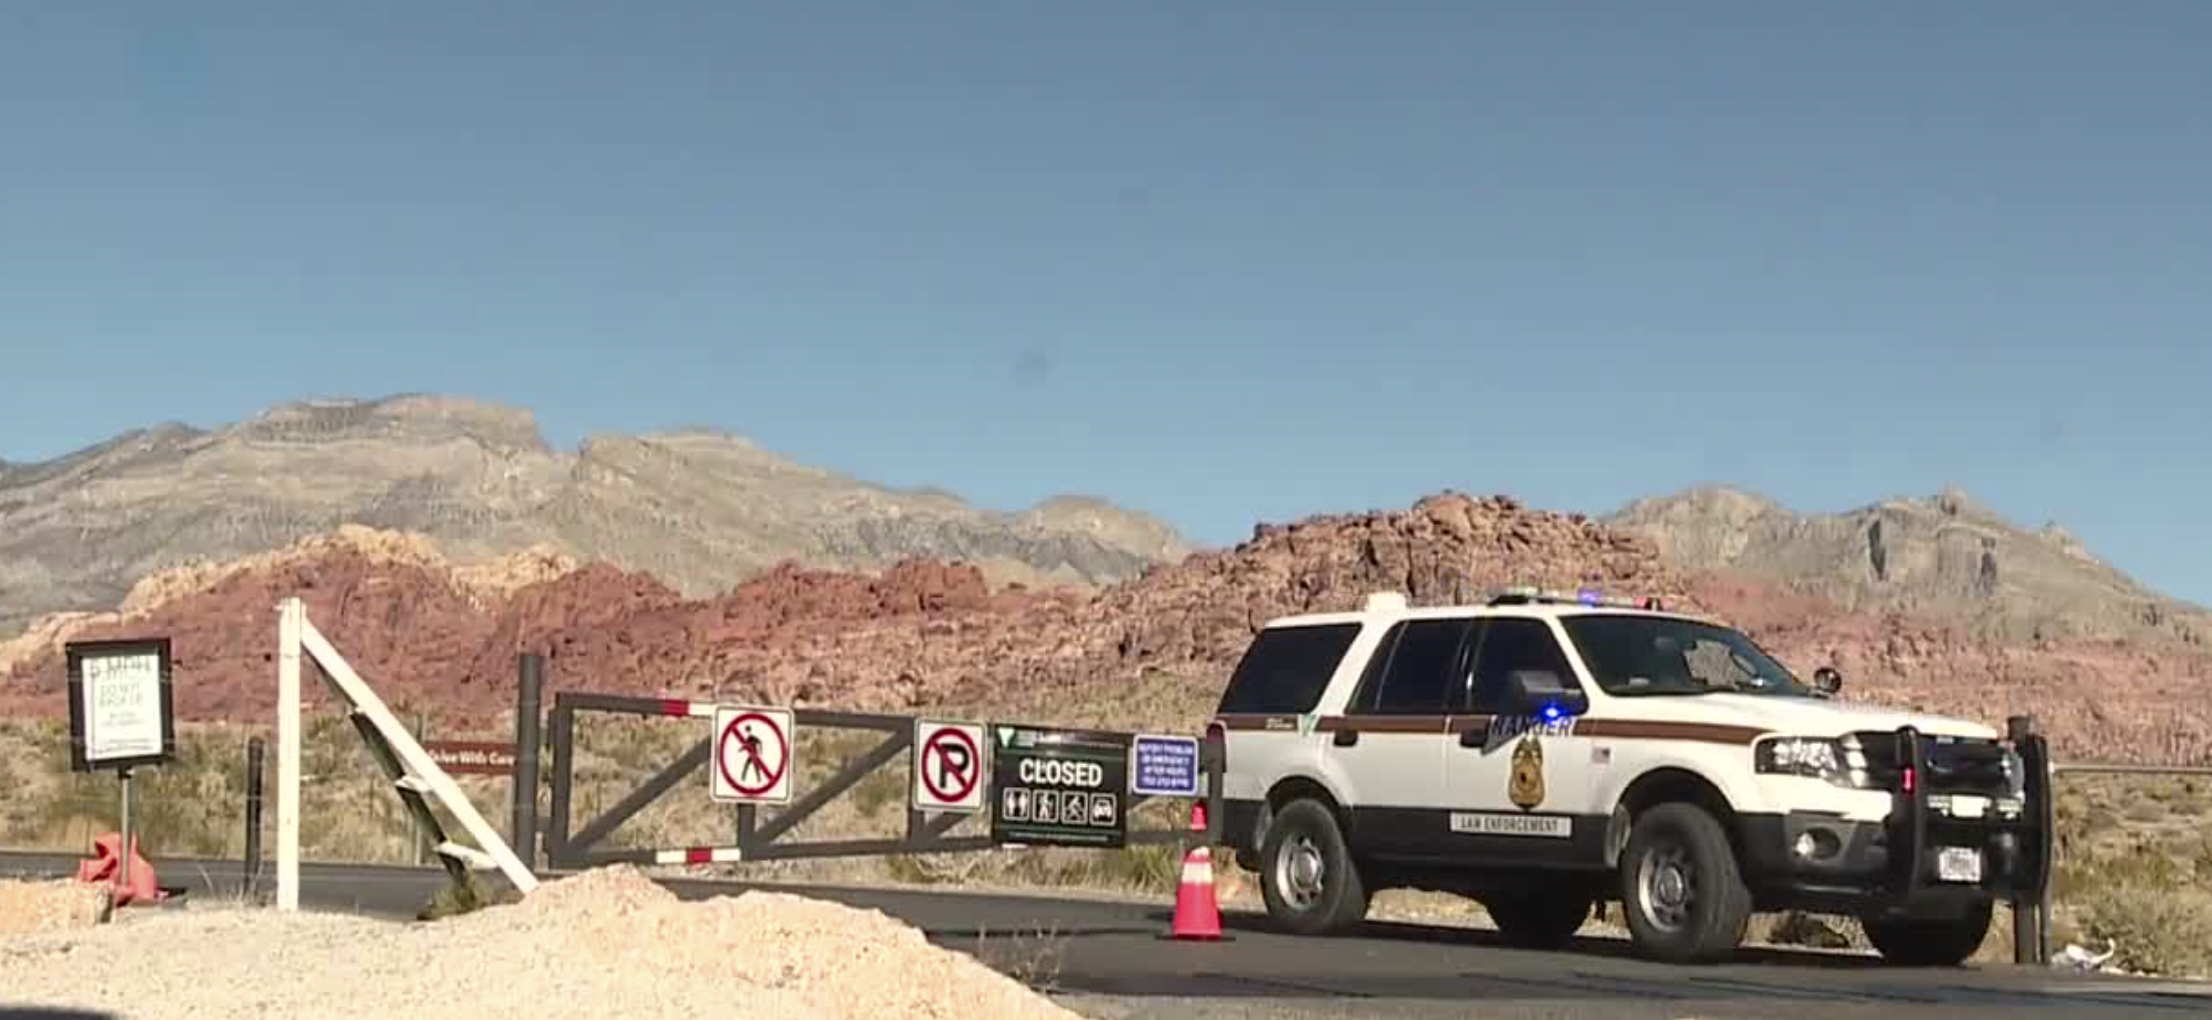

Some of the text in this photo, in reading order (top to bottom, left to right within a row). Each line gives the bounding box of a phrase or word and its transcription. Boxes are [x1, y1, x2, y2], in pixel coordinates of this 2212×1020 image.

[1020, 757, 1103, 787] CLOSED
[1461, 815, 1559, 833] LAW ENFORCEMENT
